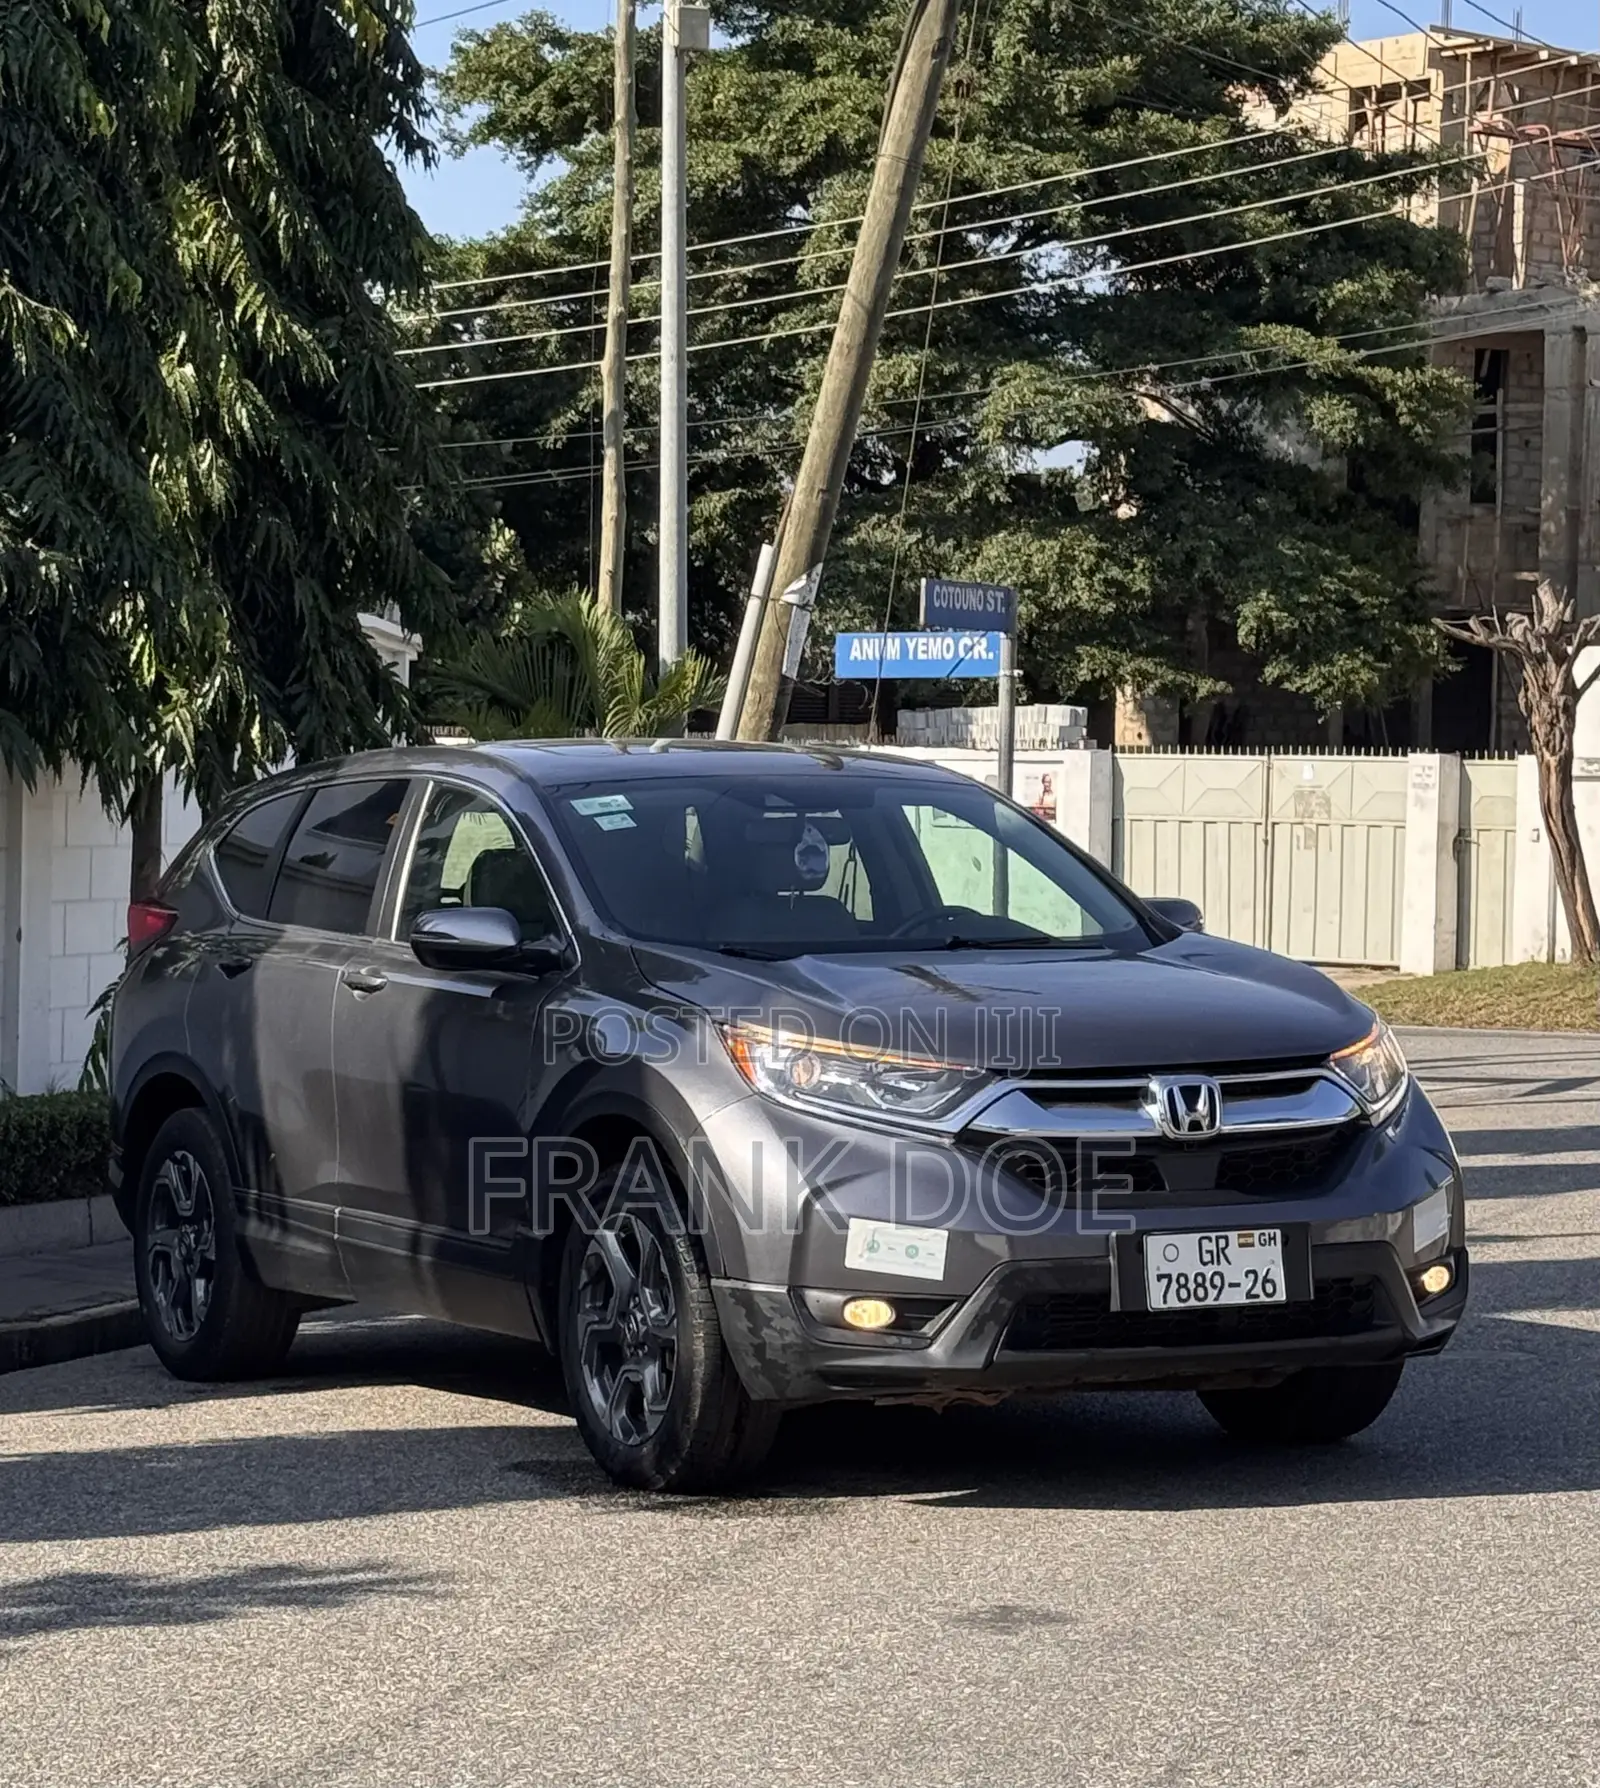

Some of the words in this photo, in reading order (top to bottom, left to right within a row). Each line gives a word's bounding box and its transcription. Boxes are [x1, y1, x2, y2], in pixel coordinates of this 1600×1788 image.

[933, 584, 984, 612] COTOUNO
[986, 590, 1006, 613] ST.
[850, 637, 900, 661] ANUM
[905, 636, 955, 661] YEMO
[958, 636, 994, 660] CR.
[1198, 1234, 1232, 1267] GR
[1258, 1231, 1277, 1248] GH
[1156, 1267, 1277, 1305] 7889-26
